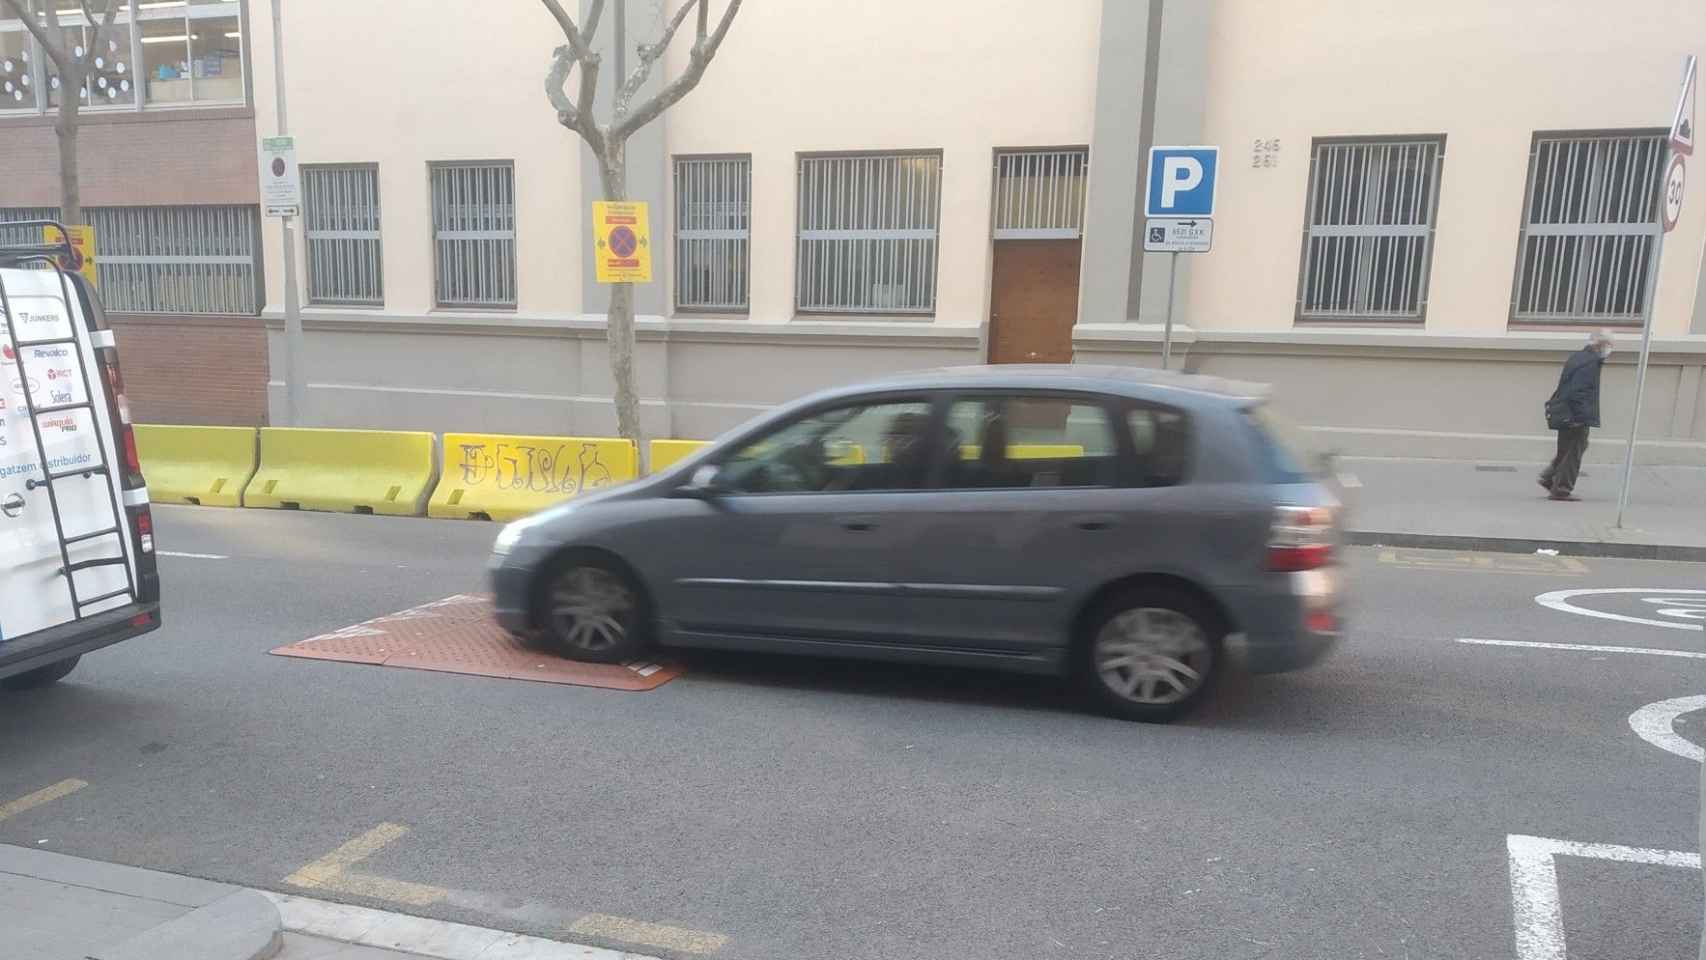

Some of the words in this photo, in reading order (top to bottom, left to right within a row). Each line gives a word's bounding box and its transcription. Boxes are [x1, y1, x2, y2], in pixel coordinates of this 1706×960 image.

[1161, 157, 1203, 208] P
[1669, 181, 1681, 205] 30
[29, 313, 60, 323] JUNKERS
[40, 453, 91, 469] stribuidor
